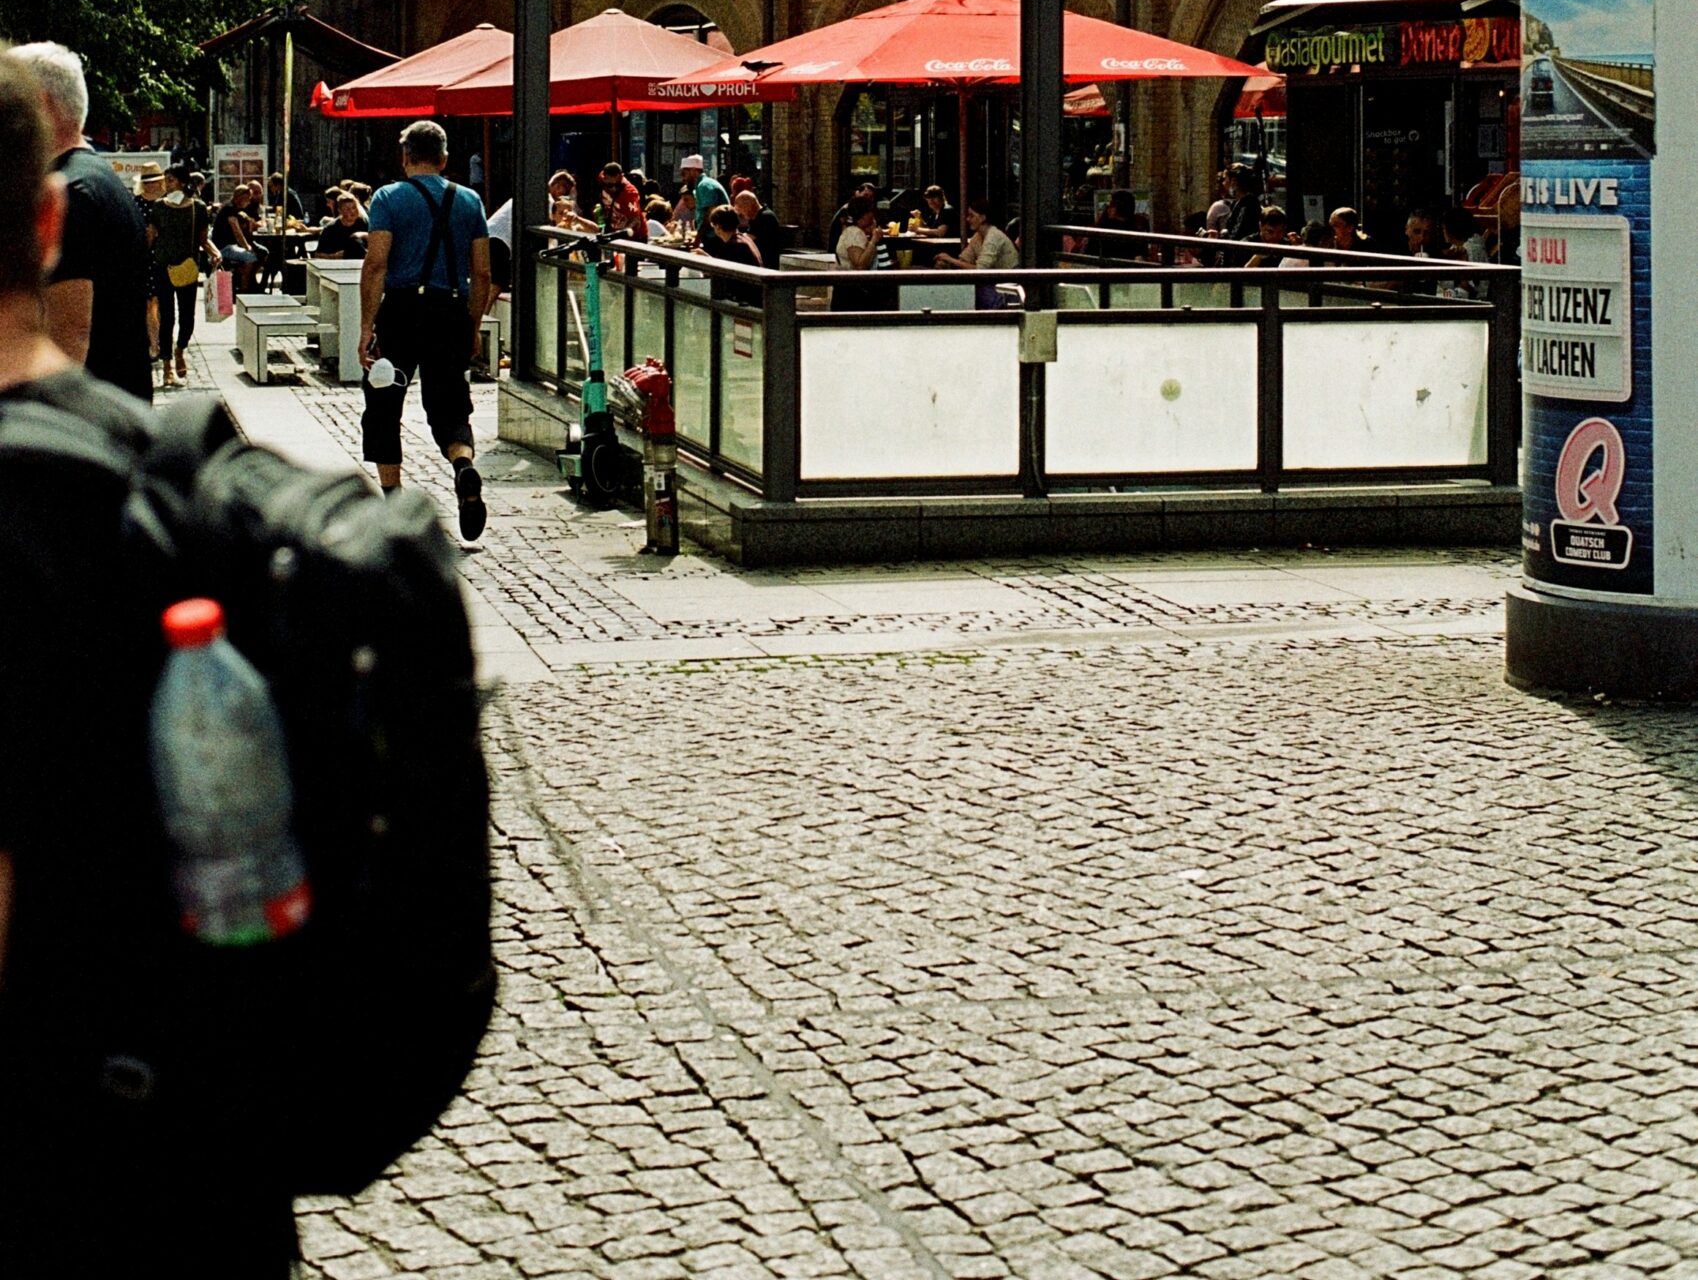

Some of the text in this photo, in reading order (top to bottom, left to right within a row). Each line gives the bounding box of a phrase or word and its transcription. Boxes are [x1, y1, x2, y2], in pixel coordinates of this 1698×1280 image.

[1280, 25, 1385, 75] asiagourmet
[924, 58, 1018, 72] Coca-Cola
[1101, 57, 1190, 71] Coca-Cola
[658, 84, 700, 97] SNACK
[1554, 177, 1618, 206] LIVE
[1540, 238, 1567, 265] JULI
[1527, 284, 1612, 325] DER LIZENZ
[1537, 338, 1595, 378] LACHEN
[1555, 417, 1626, 526] Q
[1565, 546, 1612, 561] COMEDY CLUB
[1570, 535, 1605, 549] QUATSCH
